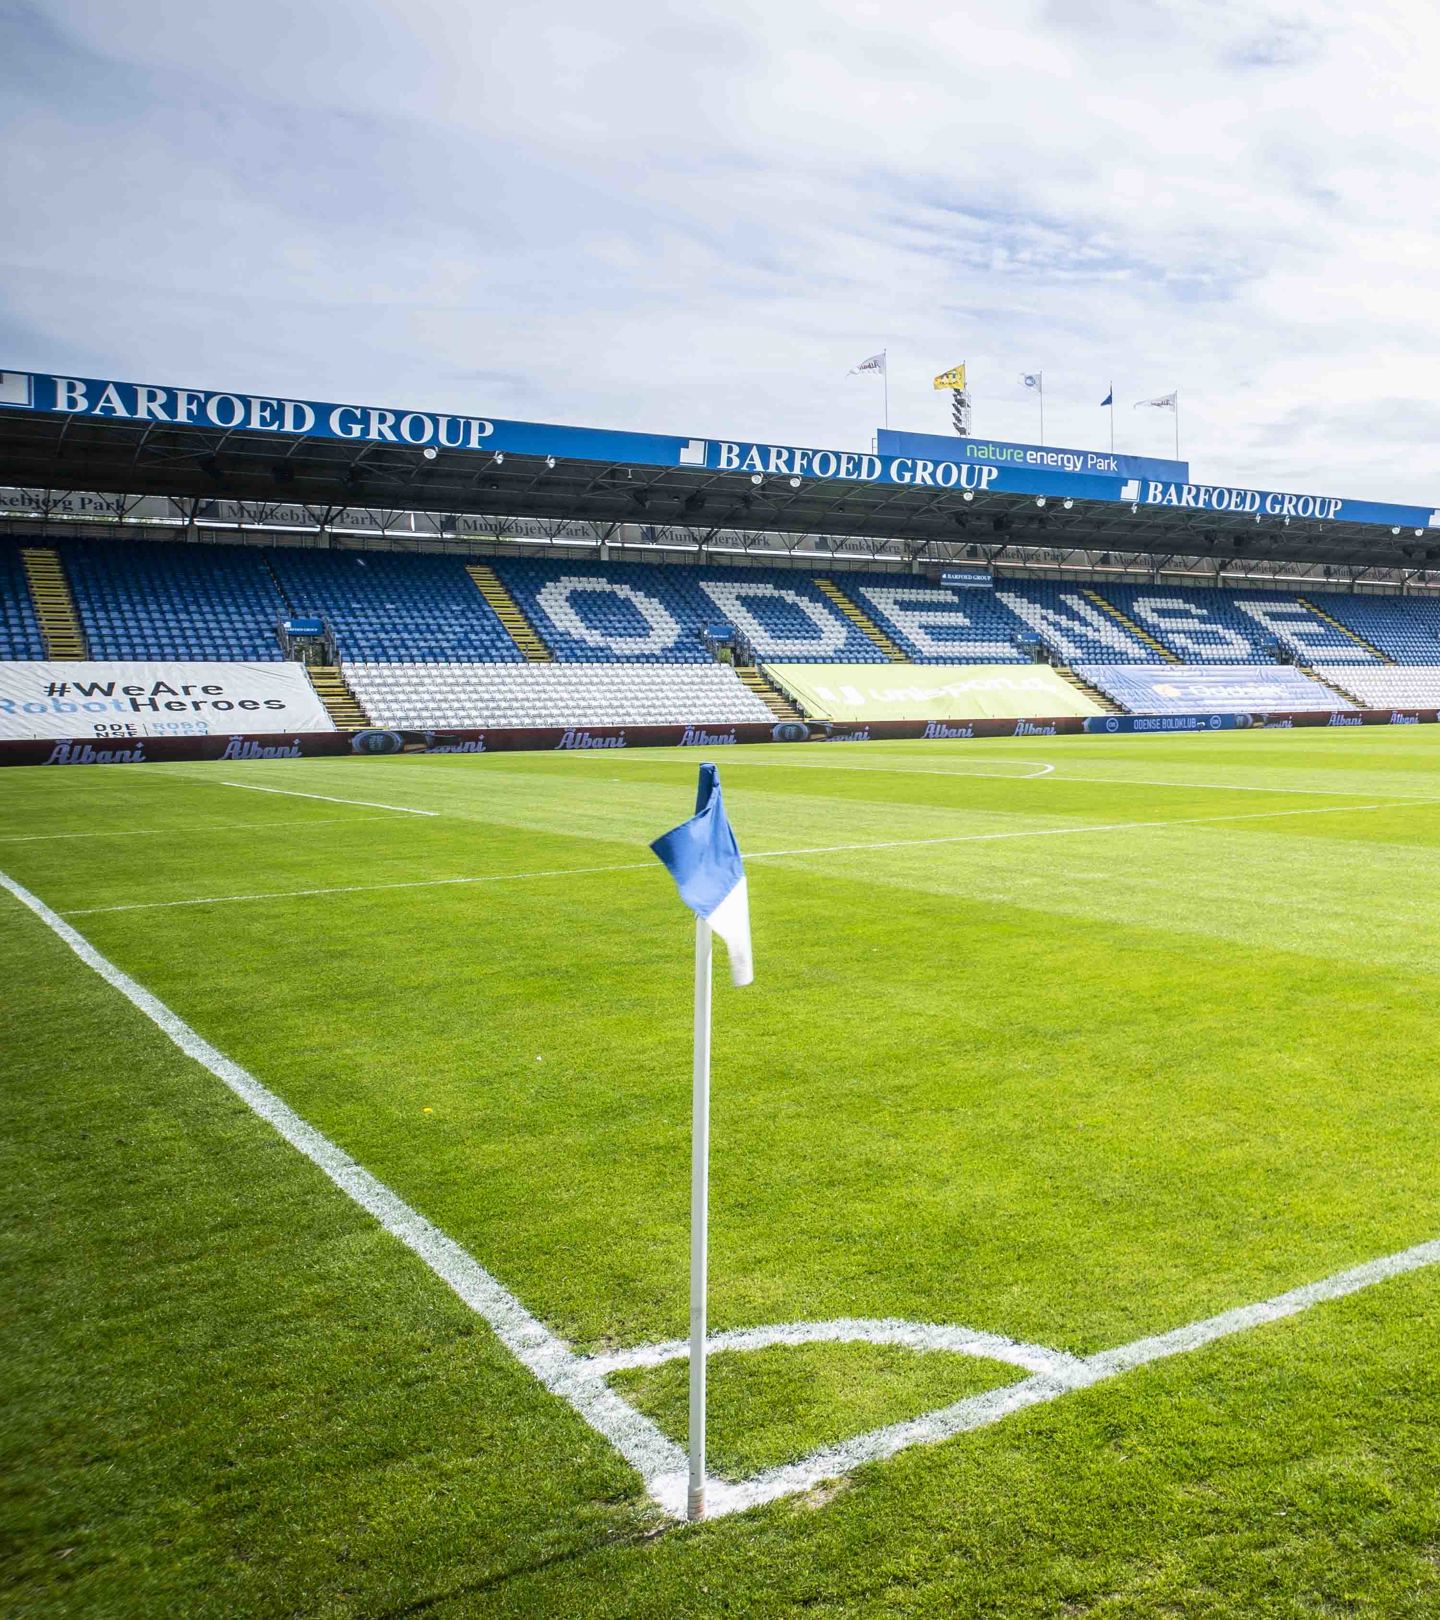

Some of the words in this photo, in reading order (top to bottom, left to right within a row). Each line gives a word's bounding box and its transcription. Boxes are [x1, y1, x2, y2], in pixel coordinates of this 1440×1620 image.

[51, 376, 316, 434] BARFOED
[328, 406, 495, 450] GROUP
[716, 441, 882, 481] BARFOED
[889, 458, 999, 490] GROUP
[966, 442, 1024, 463] nature
[1026, 450, 1084, 472] energy
[1087, 454, 1118, 472] Park
[81, 497, 125, 511] Park
[1146, 481, 1261, 512] BARFOED
[1265, 492, 1343, 520] GROUP
[535, 576, 1374, 662] ODENSE
[44, 680, 224, 697] #WeAre
[94, 723, 138, 732] ODE
[1133, 719, 1161, 730] ODENSE
[1162, 717, 1197, 729] BOLDKLUB
